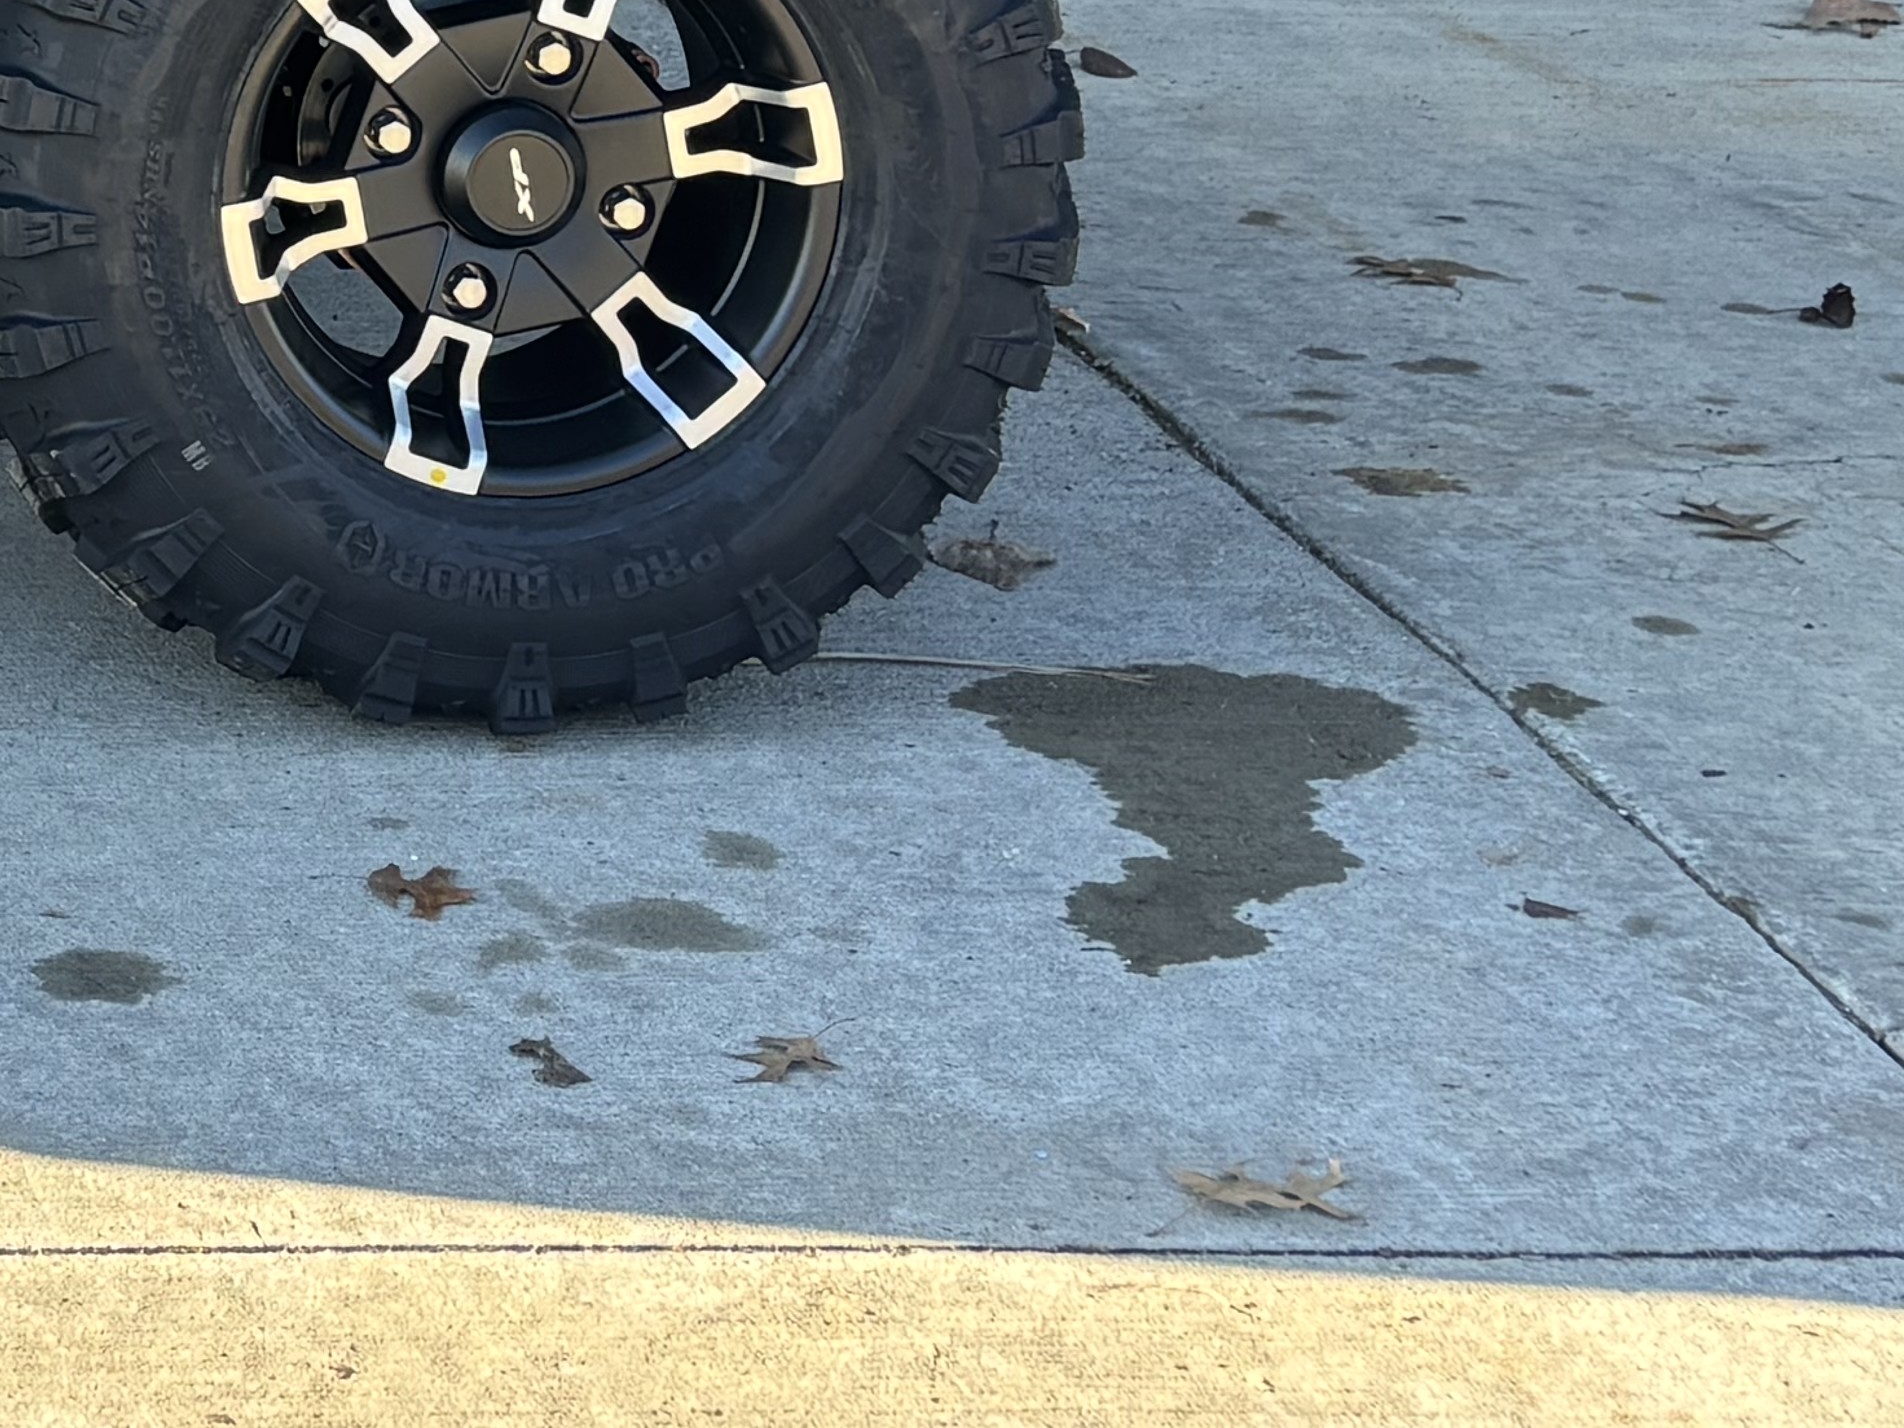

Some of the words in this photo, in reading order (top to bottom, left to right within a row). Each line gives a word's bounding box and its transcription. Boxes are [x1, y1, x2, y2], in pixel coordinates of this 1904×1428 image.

[509, 147, 535, 222] XP
[390, 548, 593, 612] ARMOR
[611, 538, 725, 600] PRO
